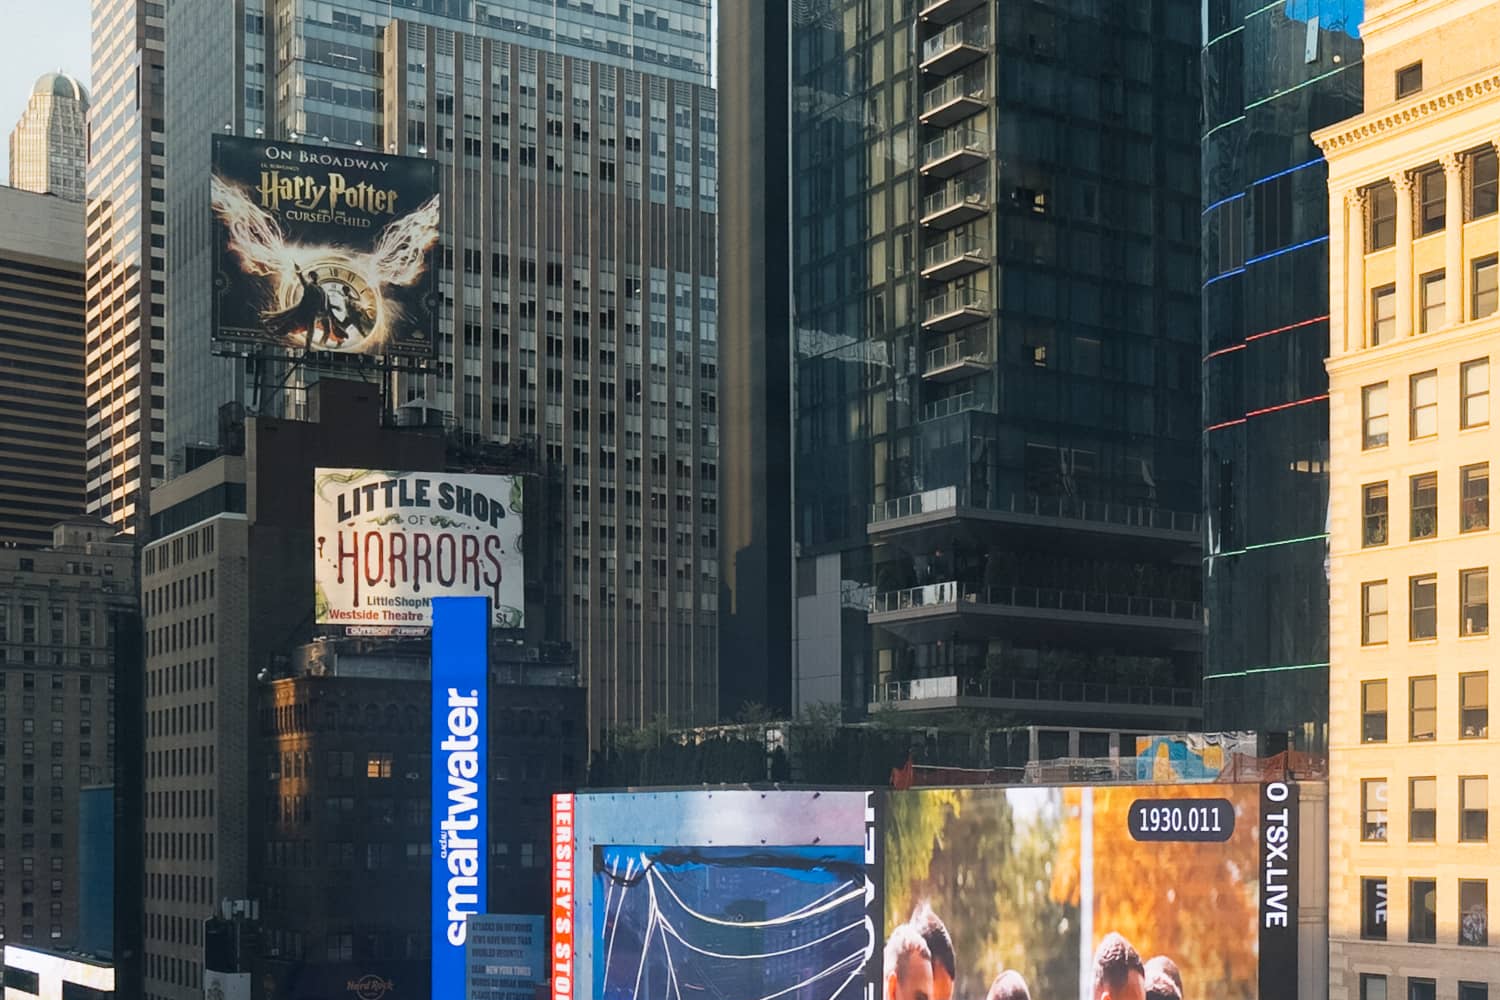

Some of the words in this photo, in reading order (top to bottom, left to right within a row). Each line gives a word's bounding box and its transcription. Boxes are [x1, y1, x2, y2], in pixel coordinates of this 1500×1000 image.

[265, 146, 292, 160] ON
[299, 150, 389, 172] BROADWAY
[256, 171, 326, 211] Harry
[328, 173, 398, 216] Potter
[286, 211, 330, 223] CURSED
[335, 215, 370, 228] CHILD
[338, 479, 430, 523] LITTLE
[438, 482, 505, 529] SHOP
[408, 515, 426, 525] OF
[337, 531, 502, 609] HORRORS
[367, 596, 432, 608] LittleShopN
[329, 610, 379, 620] Westside
[383, 610, 423, 621] Theatre
[1140, 808, 1221, 831] 1930.011
[554, 793, 572, 934] HERSHEY'S
[1266, 808, 1288, 928] TSX.LIVE
